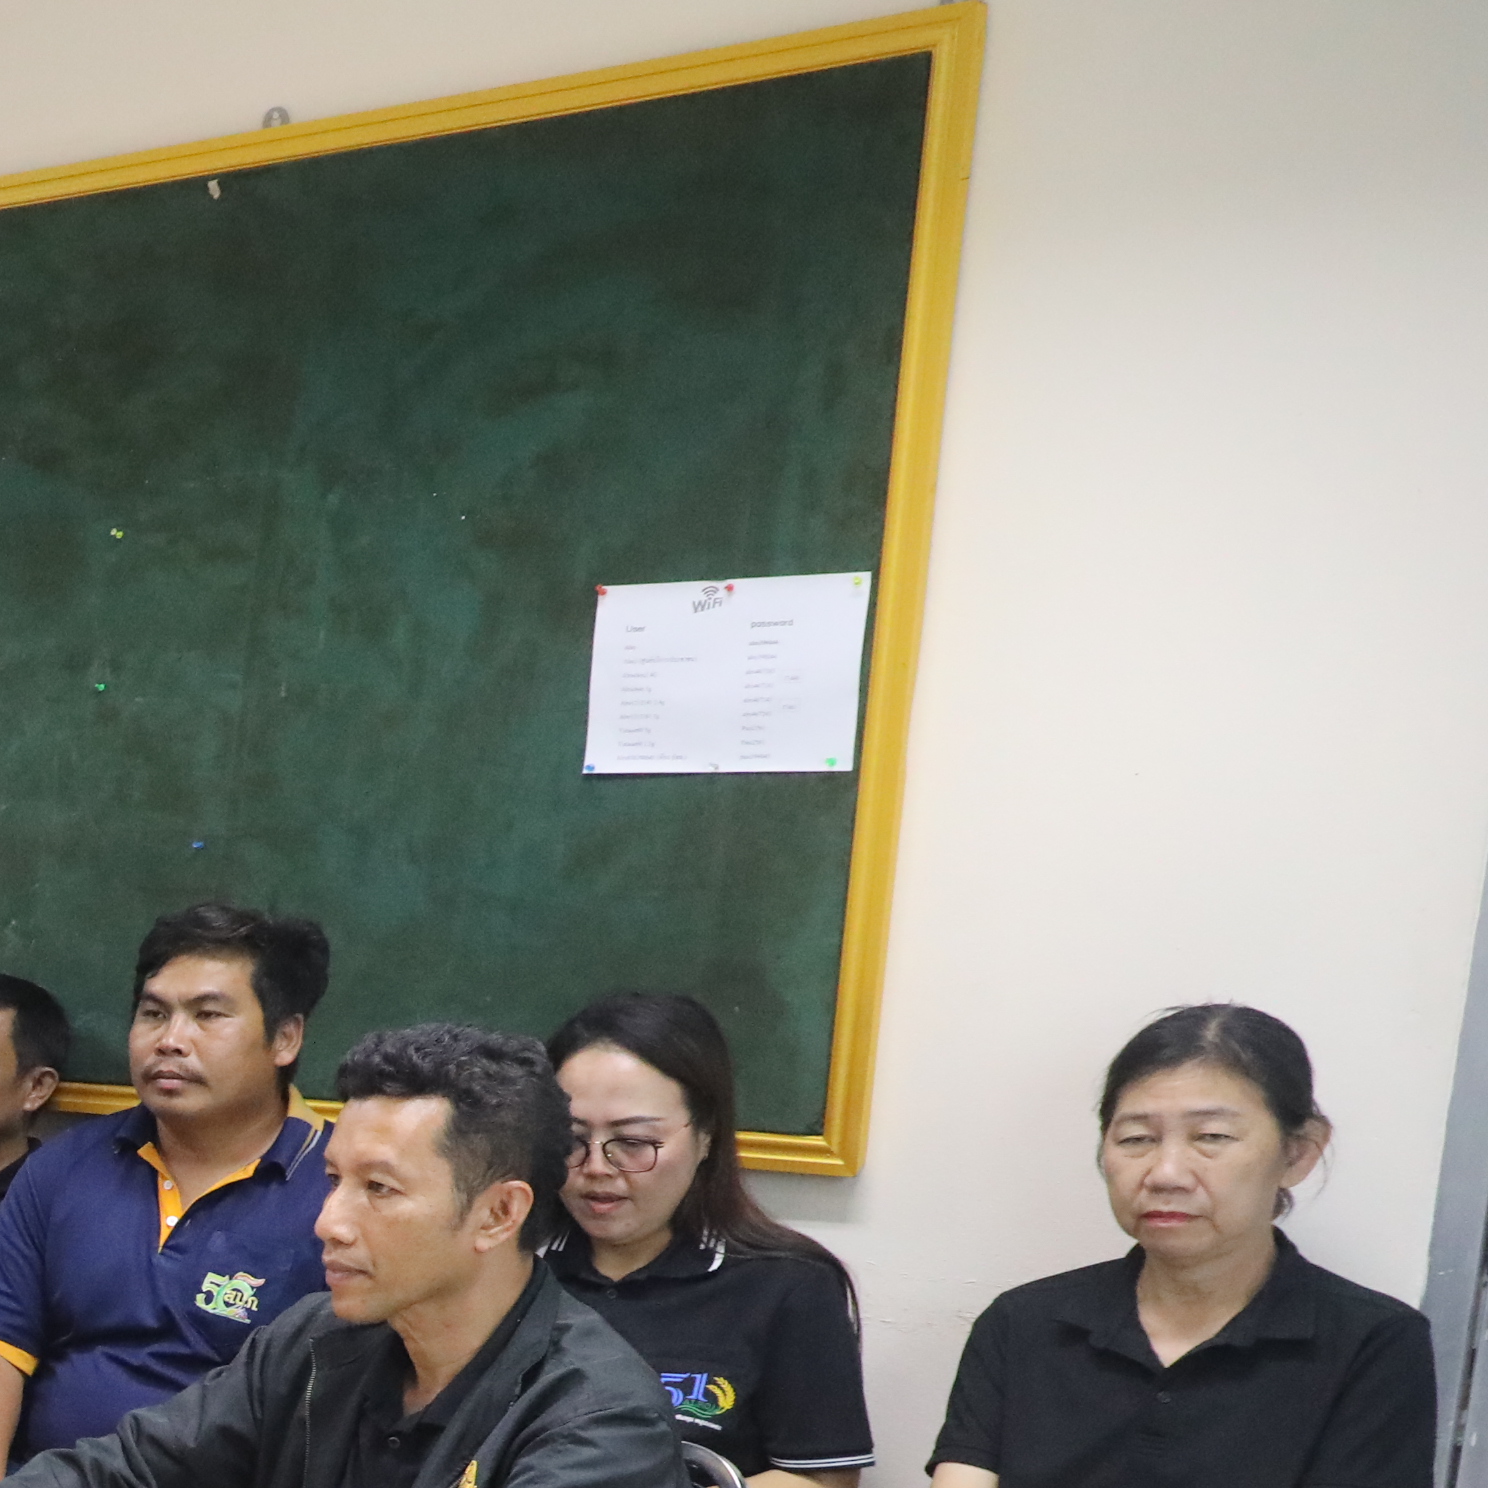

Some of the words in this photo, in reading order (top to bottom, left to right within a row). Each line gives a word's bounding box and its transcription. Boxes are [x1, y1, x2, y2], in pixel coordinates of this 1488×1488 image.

[692, 597, 723, 613] WiFi
[626, 625, 646, 633] User
[750, 619, 794, 629] password
